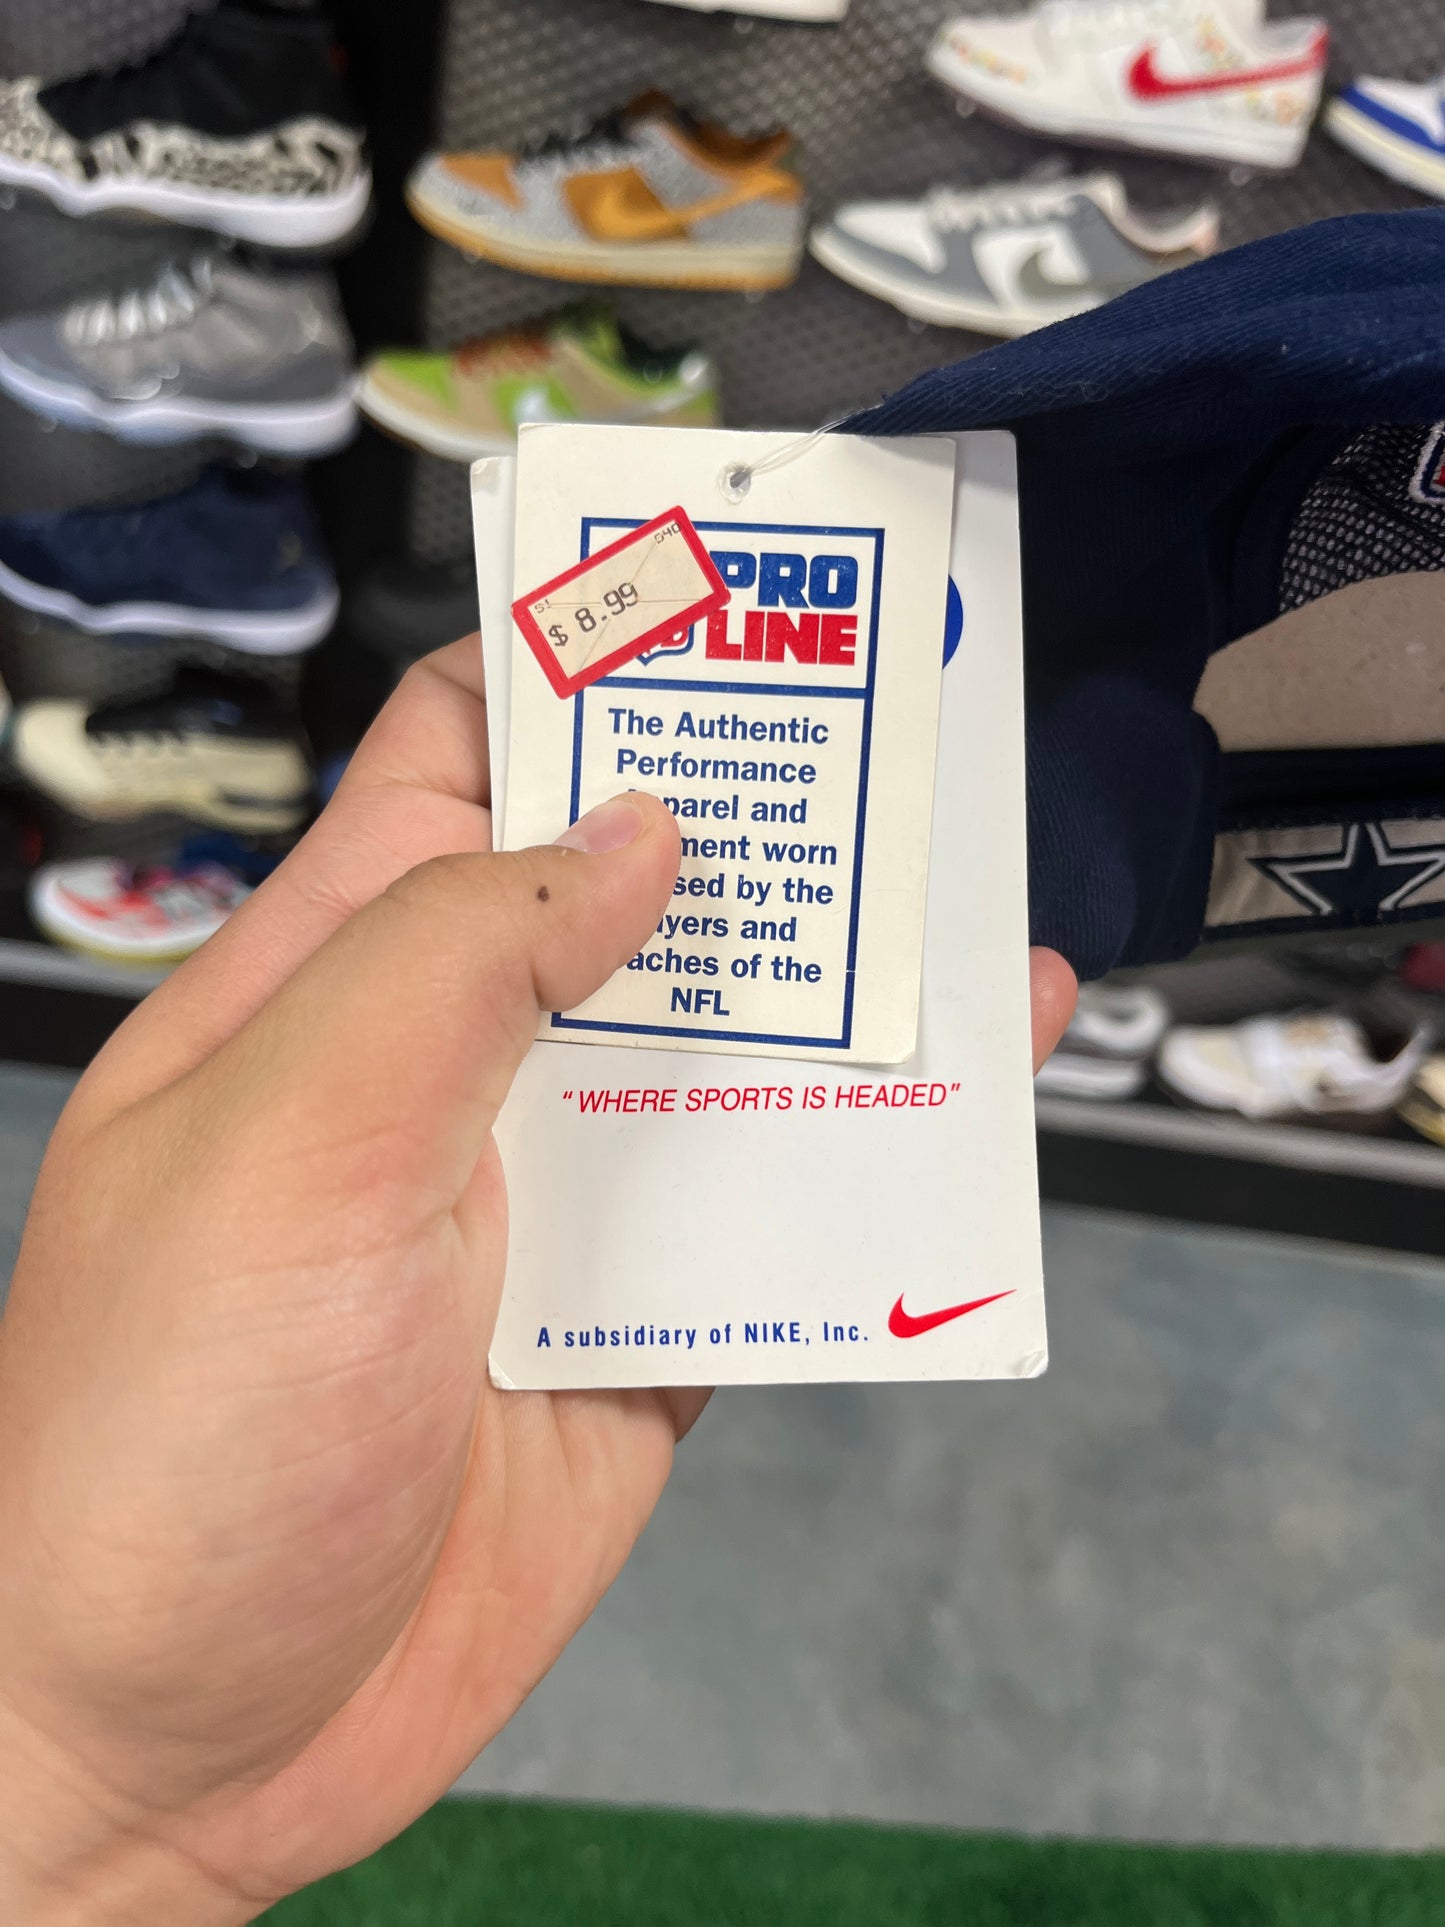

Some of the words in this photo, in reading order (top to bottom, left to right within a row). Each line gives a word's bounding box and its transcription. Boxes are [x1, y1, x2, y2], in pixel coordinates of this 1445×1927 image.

[709, 551, 858, 609] PRO
[549, 625, 568, 646] $
[575, 582, 639, 632] 8.99
[705, 610, 858, 666] LINE
[608, 708, 664, 736] The
[674, 712, 829, 744] Authentic
[616, 749, 817, 784] Performance
[750, 799, 807, 824] and
[762, 842, 838, 865] worn
[673, 873, 725, 898] sed
[737, 874, 772, 906] by
[783, 878, 834, 904] the
[740, 917, 798, 942] and
[731, 954, 762, 979] of
[771, 956, 822, 983] the
[670, 987, 730, 1016] NFL
[685, 1087, 793, 1111] SPORTS
[802, 1086, 826, 1109] IS
[537, 1327, 551, 1347] A
[564, 1325, 697, 1349] subsidiary
[709, 1323, 732, 1344] of
[744, 1322, 810, 1345] NIKE,
[823, 1321, 869, 1342] Inc.
